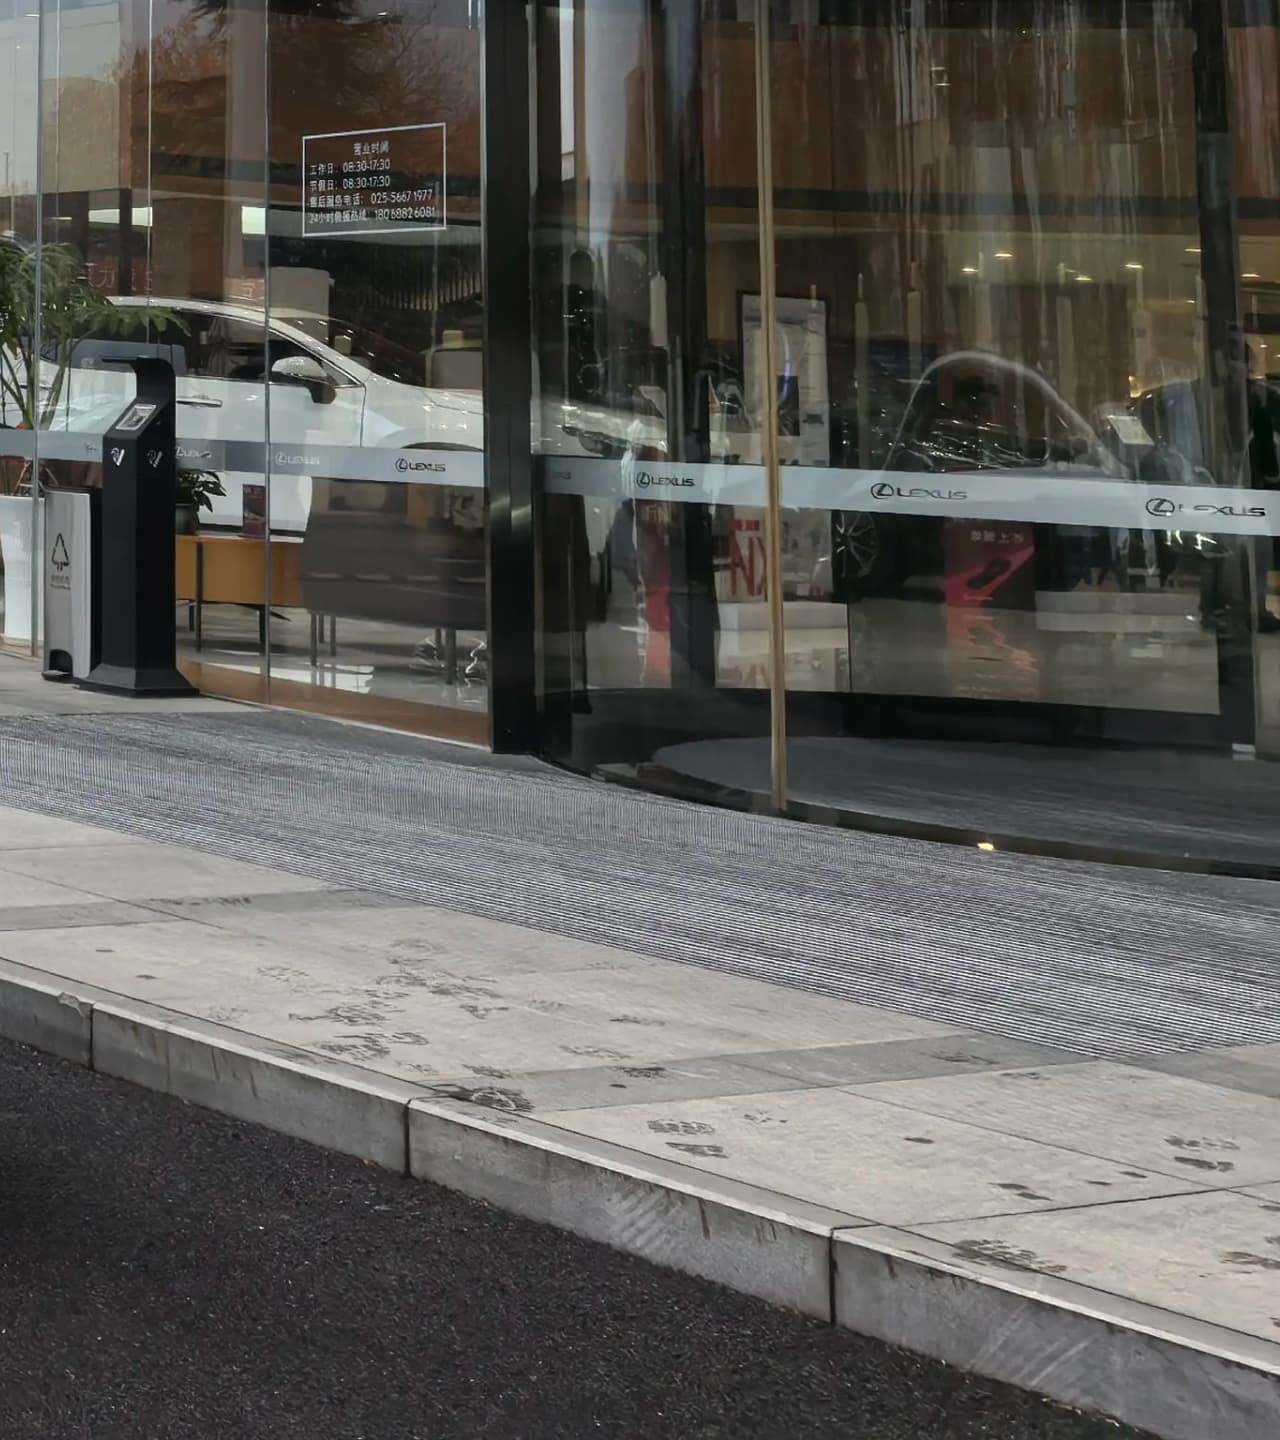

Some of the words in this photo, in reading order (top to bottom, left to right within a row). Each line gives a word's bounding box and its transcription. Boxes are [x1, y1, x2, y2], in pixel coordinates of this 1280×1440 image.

[409, 461, 446, 472] LEXUS
[651, 476, 695, 487] LEXUS
[897, 487, 968, 501] LEXUS
